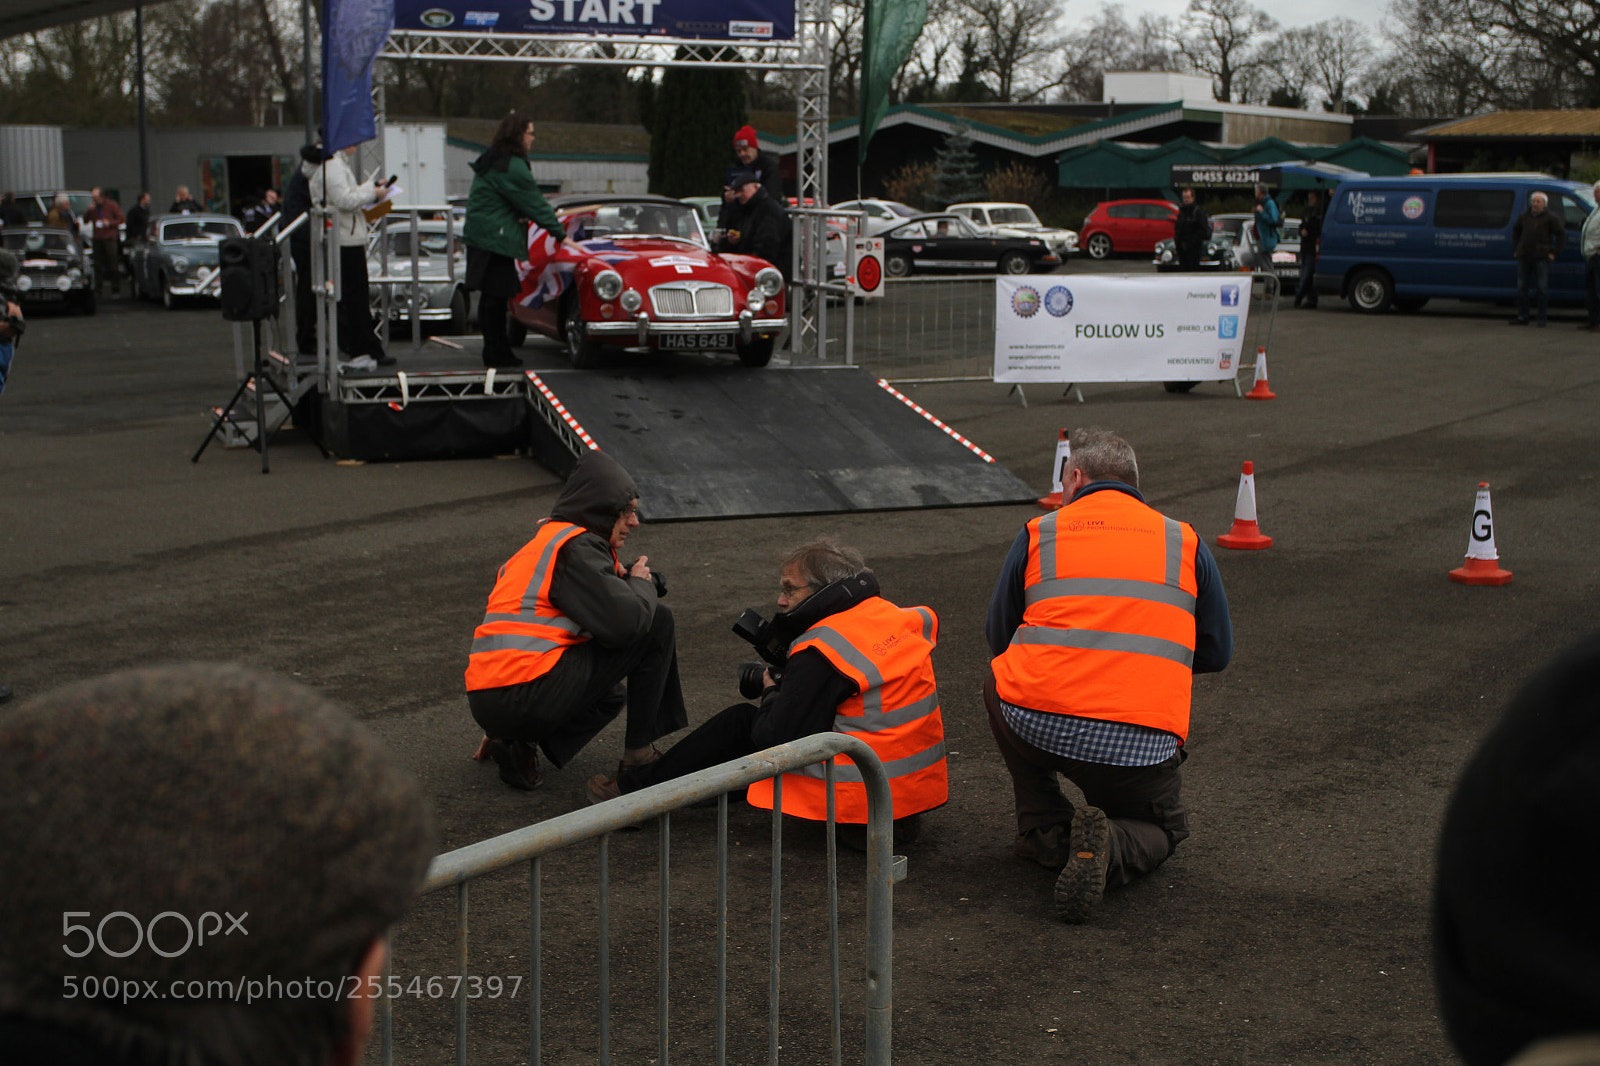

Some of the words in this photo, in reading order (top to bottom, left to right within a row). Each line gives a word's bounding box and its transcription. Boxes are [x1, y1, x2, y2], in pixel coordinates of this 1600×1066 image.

[529, 0, 661, 25] START
[1192, 171, 1223, 182] 01455
[1225, 171, 1260, 182] 612341
[1075, 324, 1140, 338] FOLLOW
[1145, 324, 1165, 338] US
[666, 334, 697, 348] HAS
[699, 334, 728, 348] 649
[1472, 509, 1492, 542] G
[883, 635, 897, 646] LIVE
